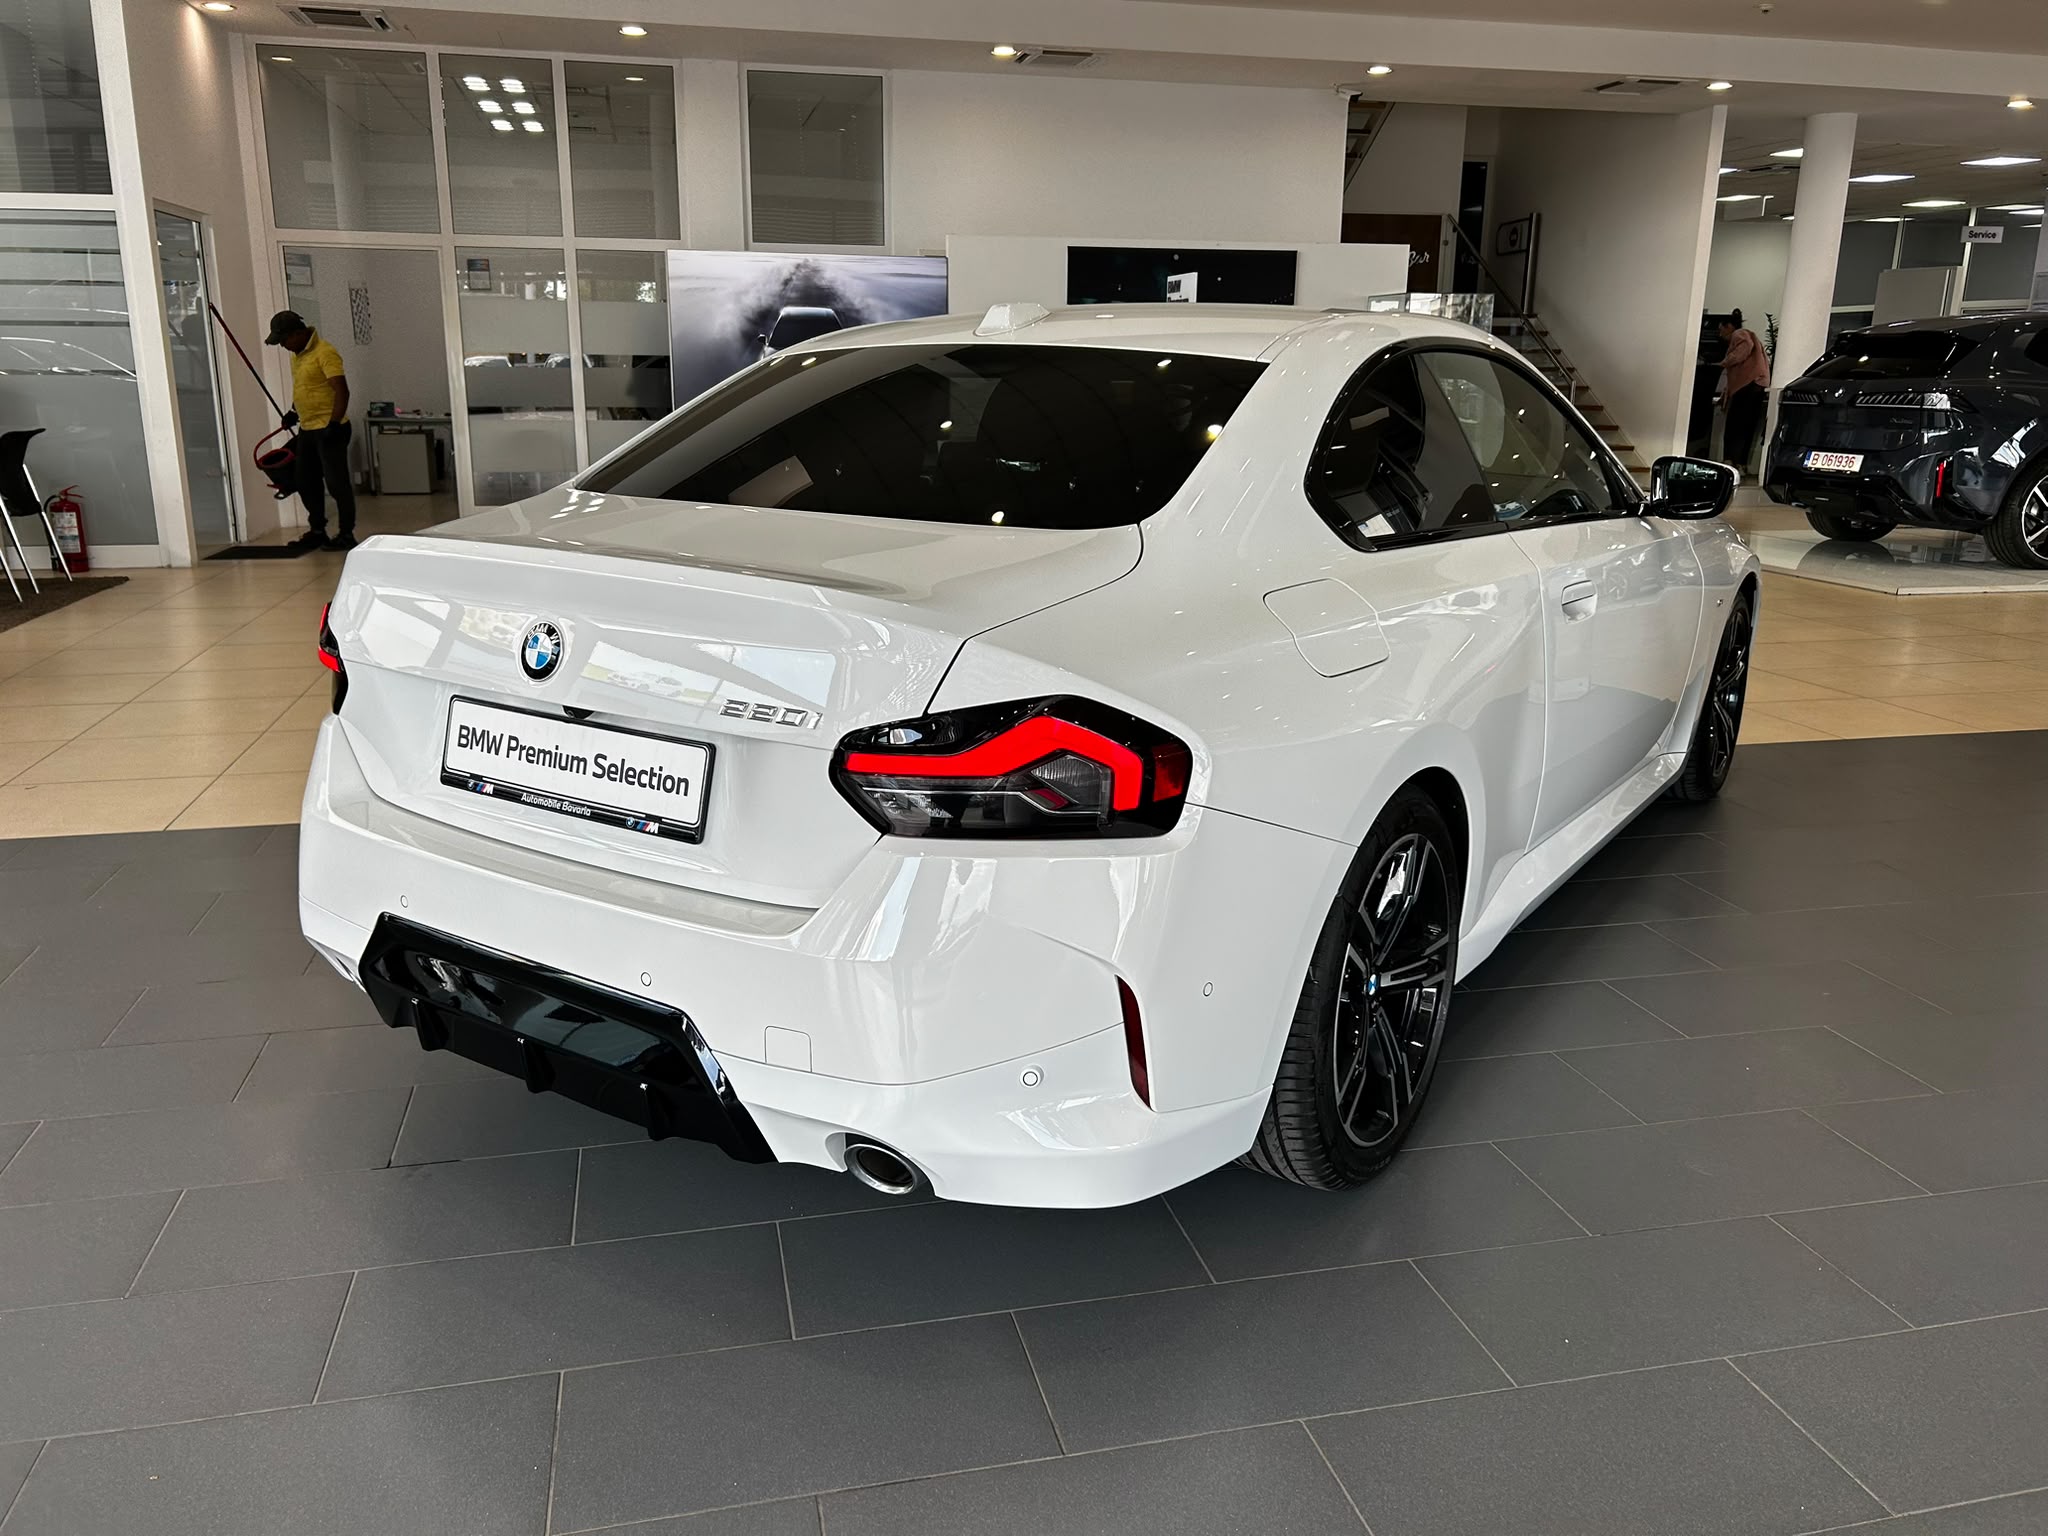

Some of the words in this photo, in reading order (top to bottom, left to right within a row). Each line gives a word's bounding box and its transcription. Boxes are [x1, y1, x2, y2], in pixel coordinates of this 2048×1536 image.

[1968, 230, 1997, 239] Service
[1811, 453, 1821, 466] B
[1821, 454, 1856, 469] 061936
[719, 698, 824, 730] 220i
[457, 723, 505, 756] BMW
[506, 734, 588, 776] Premium
[591, 752, 690, 797] Selection
[520, 792, 561, 810] Automobile
[561, 801, 592, 817] Bavaria
